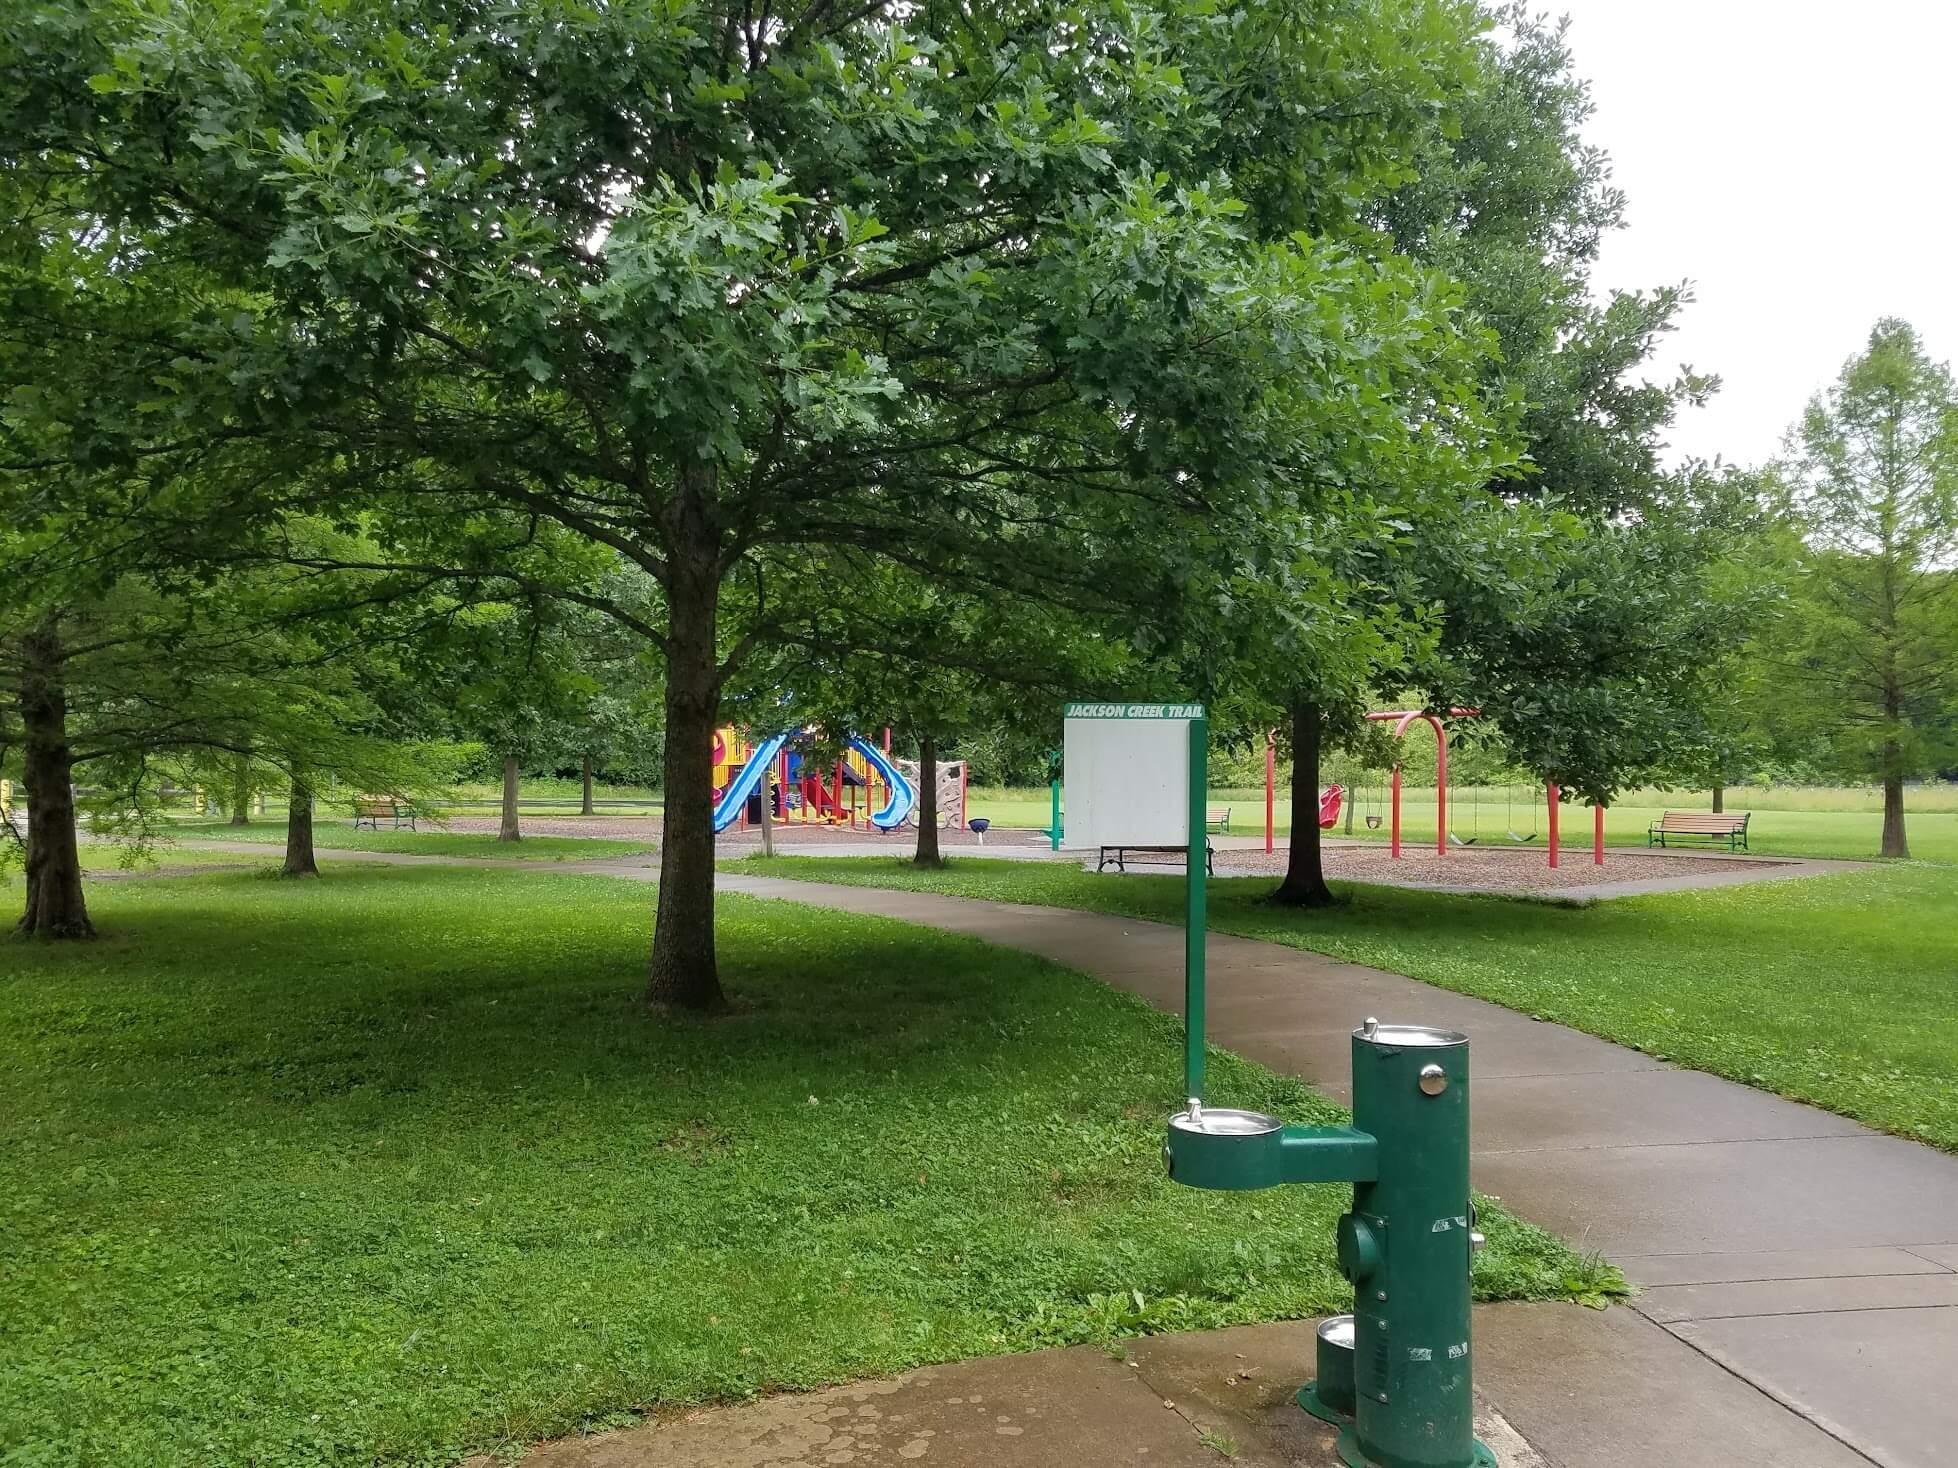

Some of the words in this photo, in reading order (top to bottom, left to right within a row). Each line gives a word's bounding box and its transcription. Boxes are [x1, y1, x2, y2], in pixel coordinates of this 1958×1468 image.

[1067, 704, 1125, 717] JACKSON
[1127, 705, 1165, 718] CREEK
[1168, 705, 1202, 718] TRAIL
